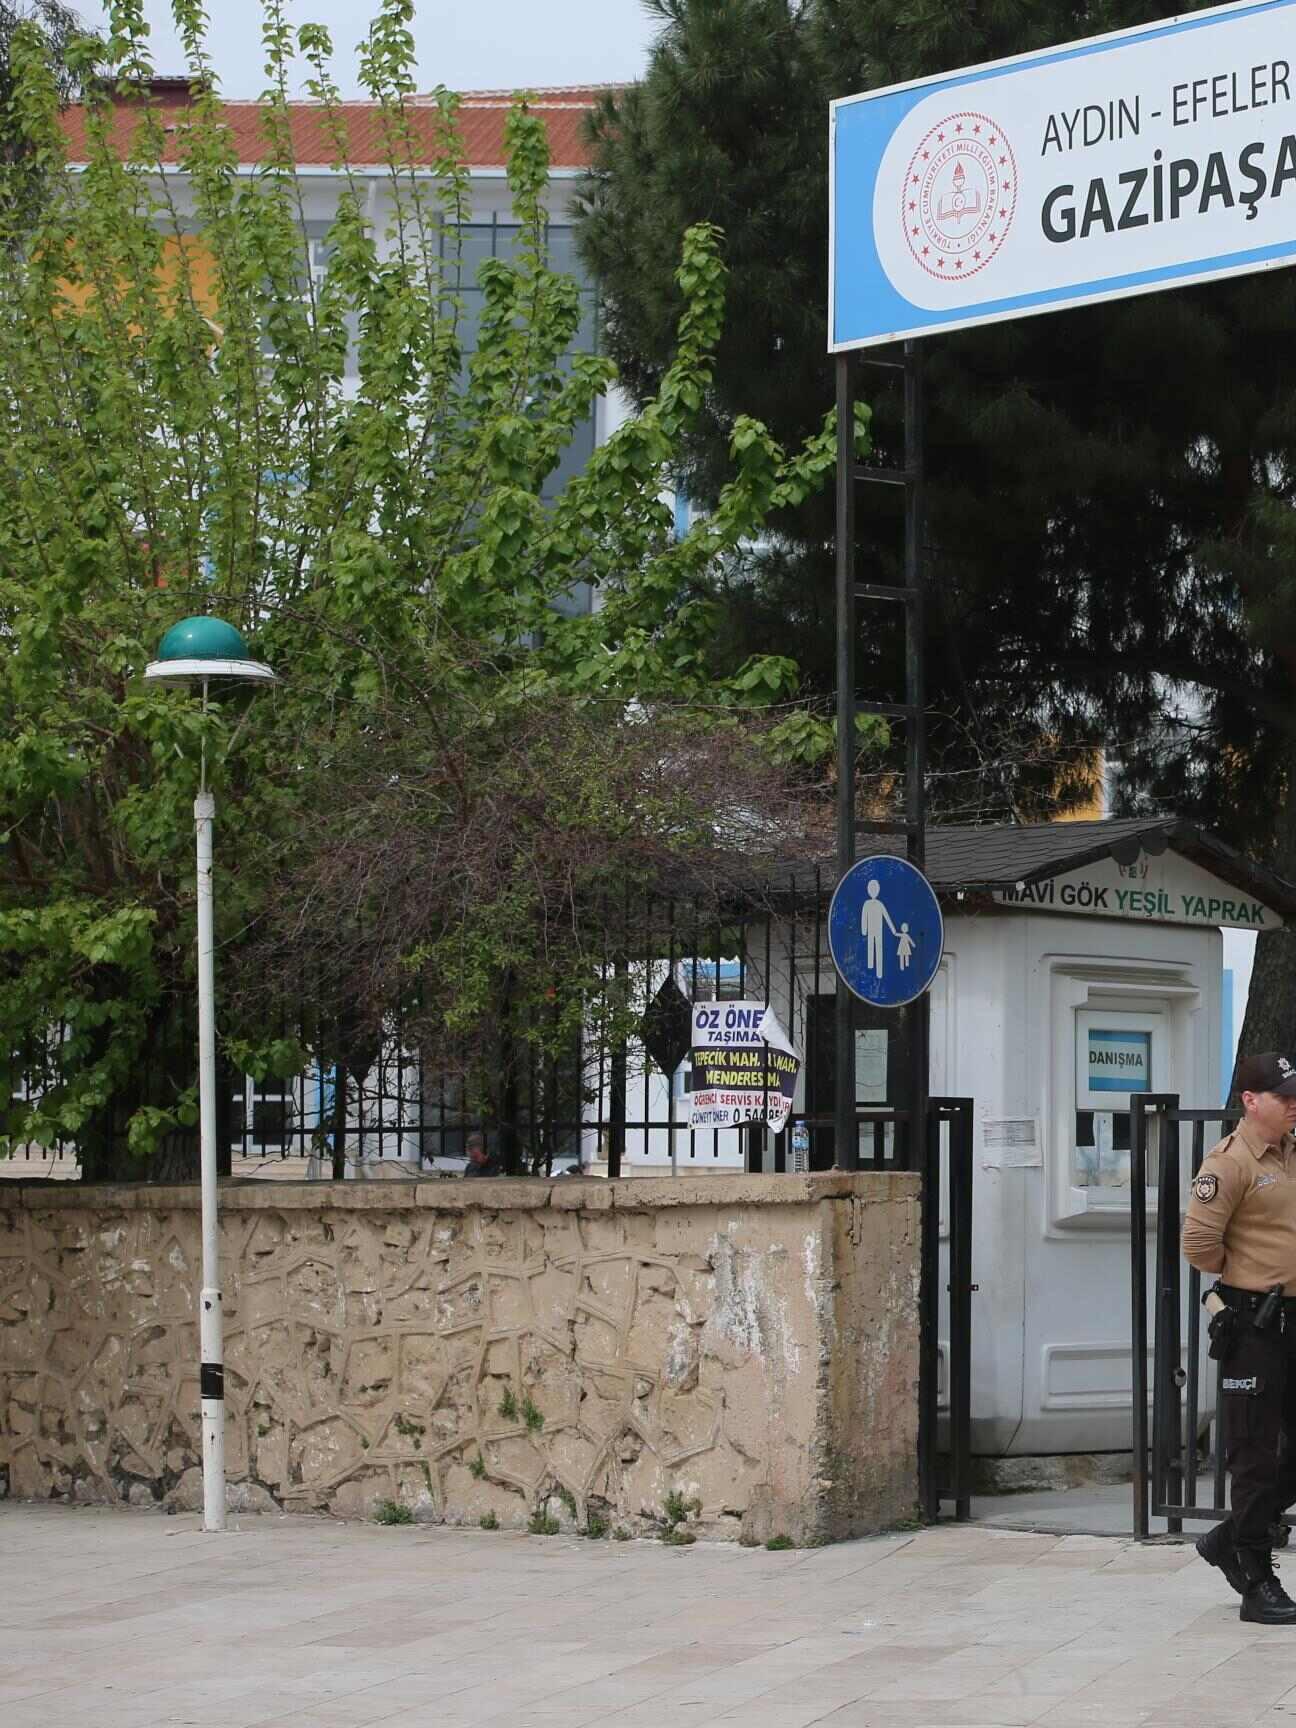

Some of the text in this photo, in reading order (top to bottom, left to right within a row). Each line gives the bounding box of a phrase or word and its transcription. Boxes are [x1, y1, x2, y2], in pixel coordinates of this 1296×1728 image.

[1041, 95, 1140, 156] AYDIN
[1172, 60, 1291, 127] EFELER
[1002, 879, 1265, 925] MAVİ GÖK YEŞİL YAPRAK
[695, 1004, 720, 1029] ÖZ
[694, 1048, 726, 1066] TEPECİK
[729, 1052, 761, 1067] MAH.
[1089, 1050, 1143, 1069] DANIŞMA
[705, 1070, 764, 1086] MENDERES
[720, 1092, 752, 1106] SERVİS
